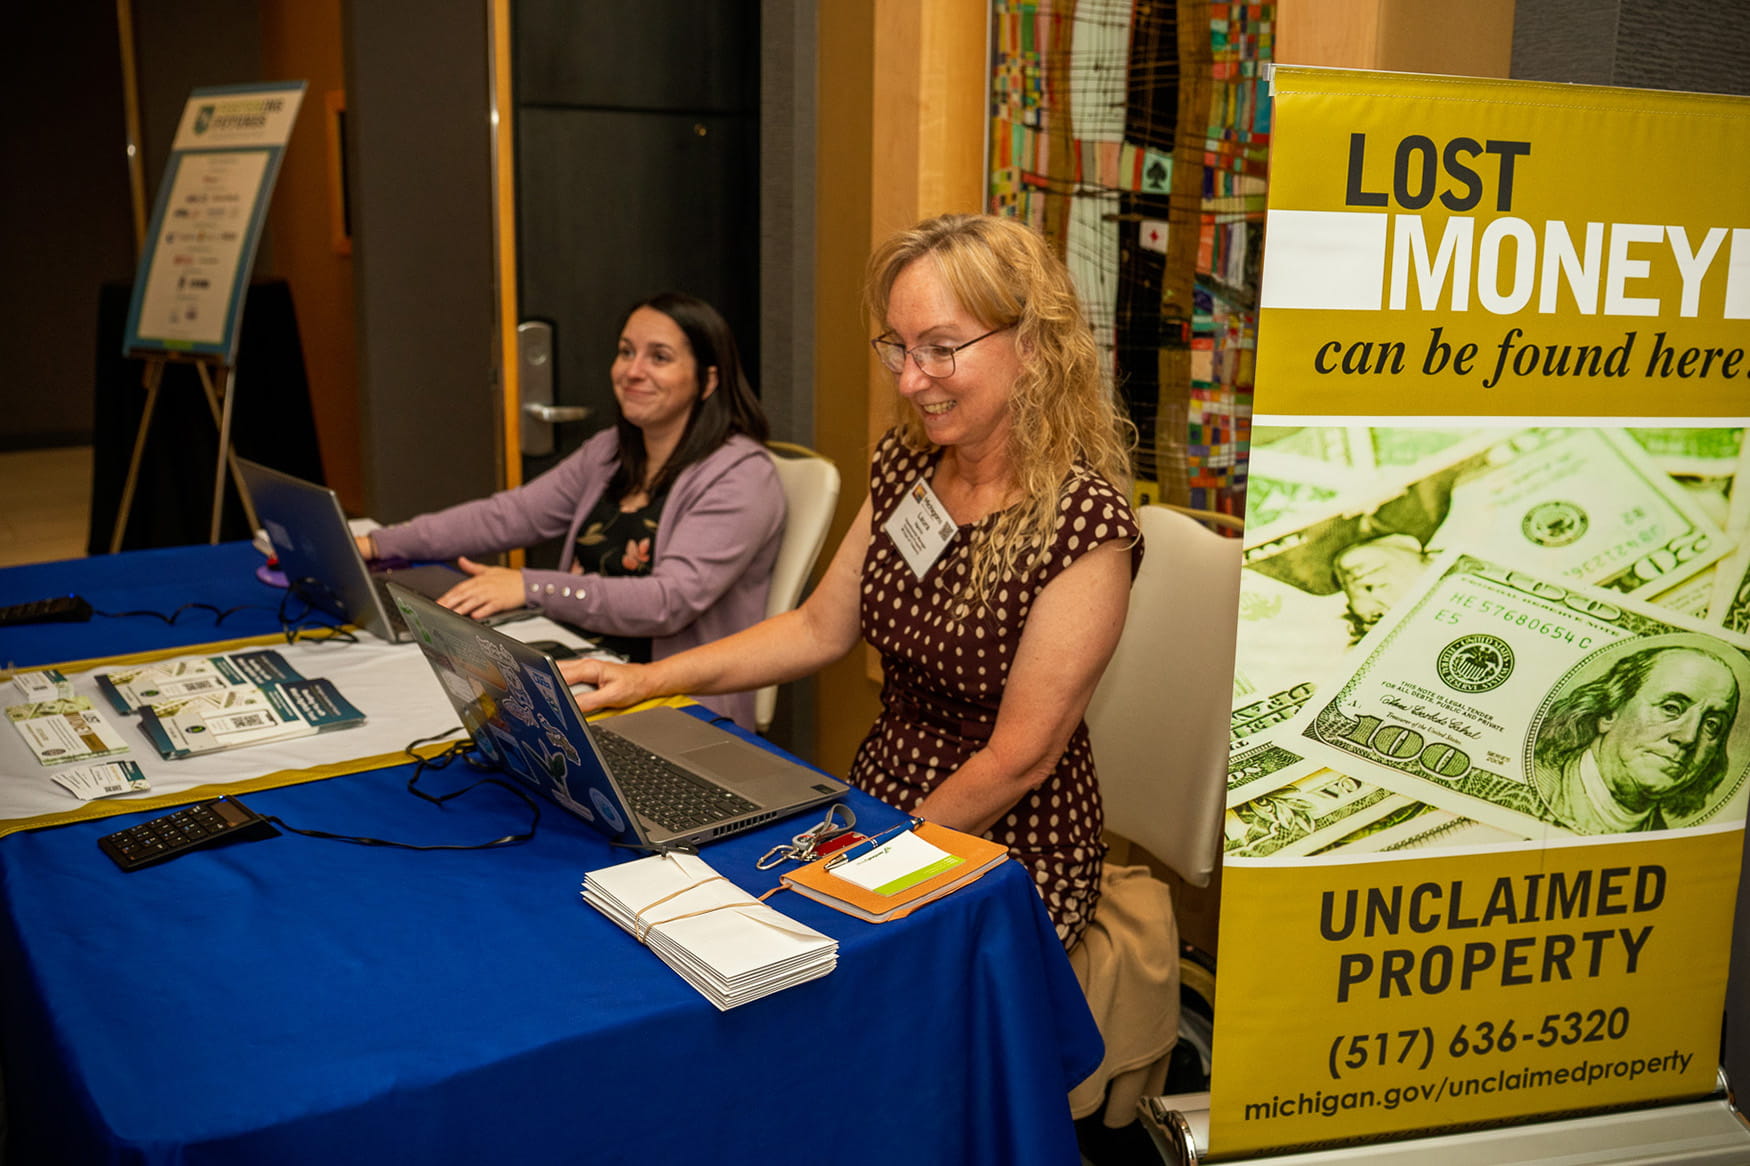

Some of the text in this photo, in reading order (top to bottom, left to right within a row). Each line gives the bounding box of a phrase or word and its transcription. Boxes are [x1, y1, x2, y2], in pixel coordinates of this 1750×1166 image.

[1345, 132, 1531, 212] LOST
[1389, 213, 1729, 318] MONEY
[1314, 337, 1405, 375] can
[1422, 326, 1478, 376] be
[1482, 328, 1638, 388] found
[1478, 600, 1576, 645] 57680654
[1381, 681, 1397, 690] FOR
[1397, 685, 1409, 694] ALL
[1436, 700, 1462, 714] PUBLIC
[1462, 710, 1478, 721] AND
[1478, 716, 1506, 733] PRIVATE
[1417, 686, 1435, 698] NOTE
[1445, 696, 1466, 710] LEGAL
[1466, 705, 1494, 721] TENDER
[1340, 713, 1473, 780] 100
[1319, 864, 1667, 942] UNCLAIMED
[1336, 926, 1654, 1003] PROPERTY
[1329, 1006, 1630, 1079] (517) 636-5320
[1244, 1049, 1693, 1121] michigan.gov/unclaimedproperty
